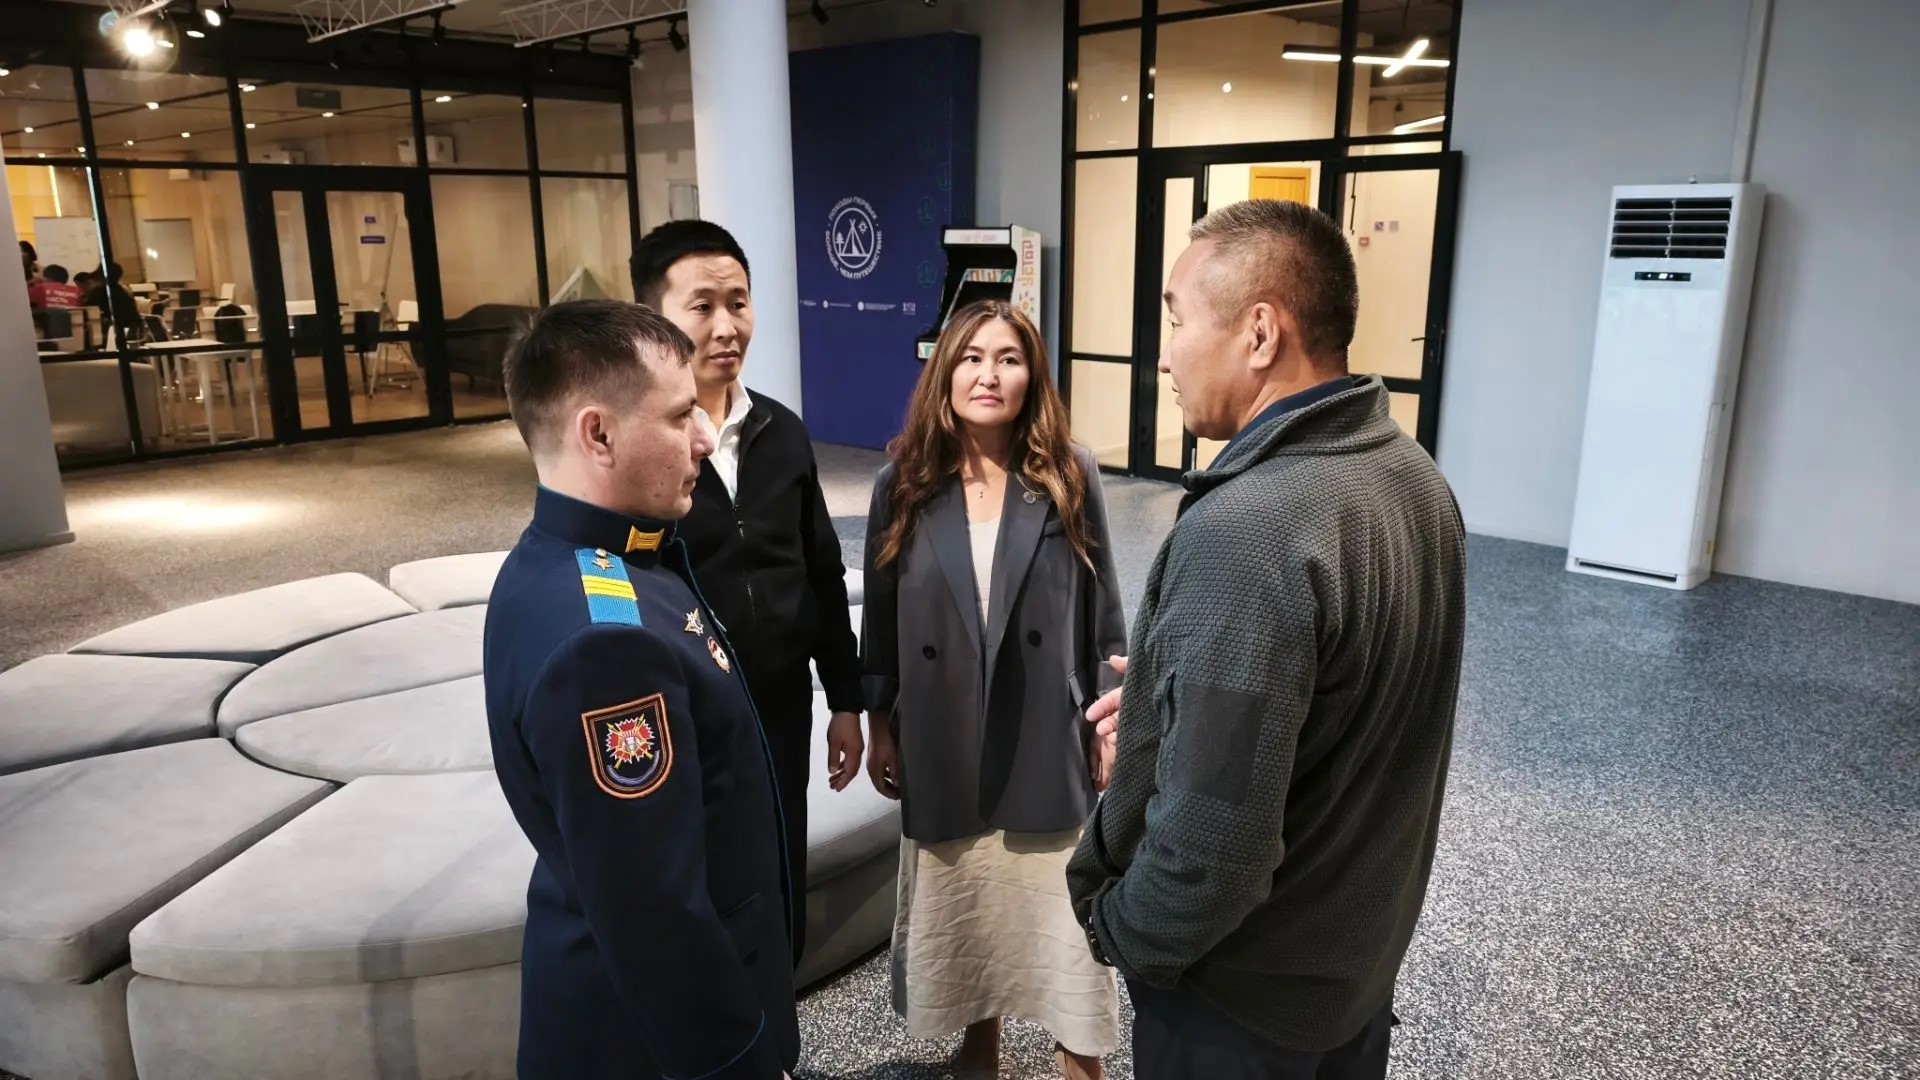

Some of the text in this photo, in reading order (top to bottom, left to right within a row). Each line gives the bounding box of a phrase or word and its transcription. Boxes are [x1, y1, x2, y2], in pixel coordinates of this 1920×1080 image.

[829, 197, 877, 220] ПОХОДЫ ПЕРВЫХ
[839, 267, 853, 279] ЧЕМ
[853, 230, 882, 279] ПУТЕШЕСТВИЕ
